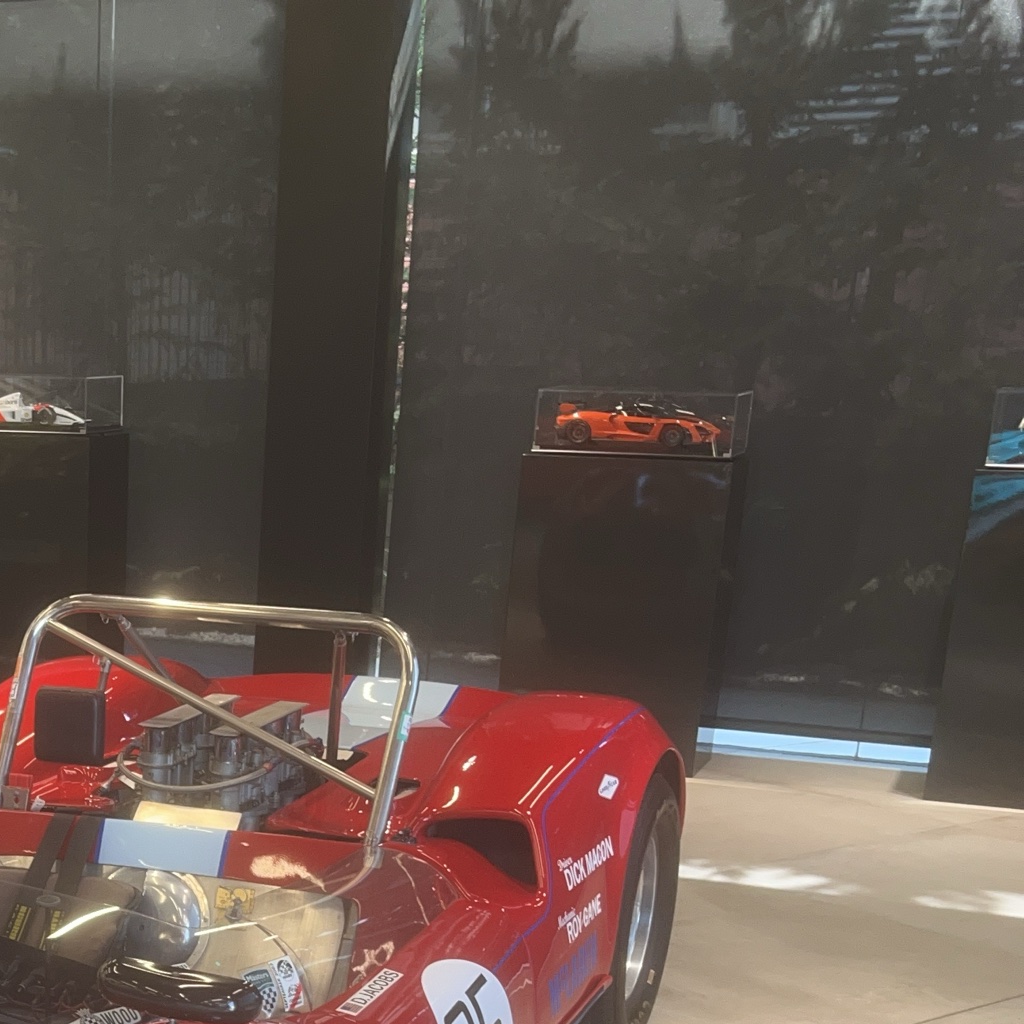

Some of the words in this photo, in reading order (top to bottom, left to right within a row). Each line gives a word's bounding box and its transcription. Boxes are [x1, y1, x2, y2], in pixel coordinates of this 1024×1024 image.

[563, 857, 587, 891] DICK
[584, 835, 614, 876] MACON
[566, 911, 582, 944] ROY
[582, 893, 602, 928] GANE
